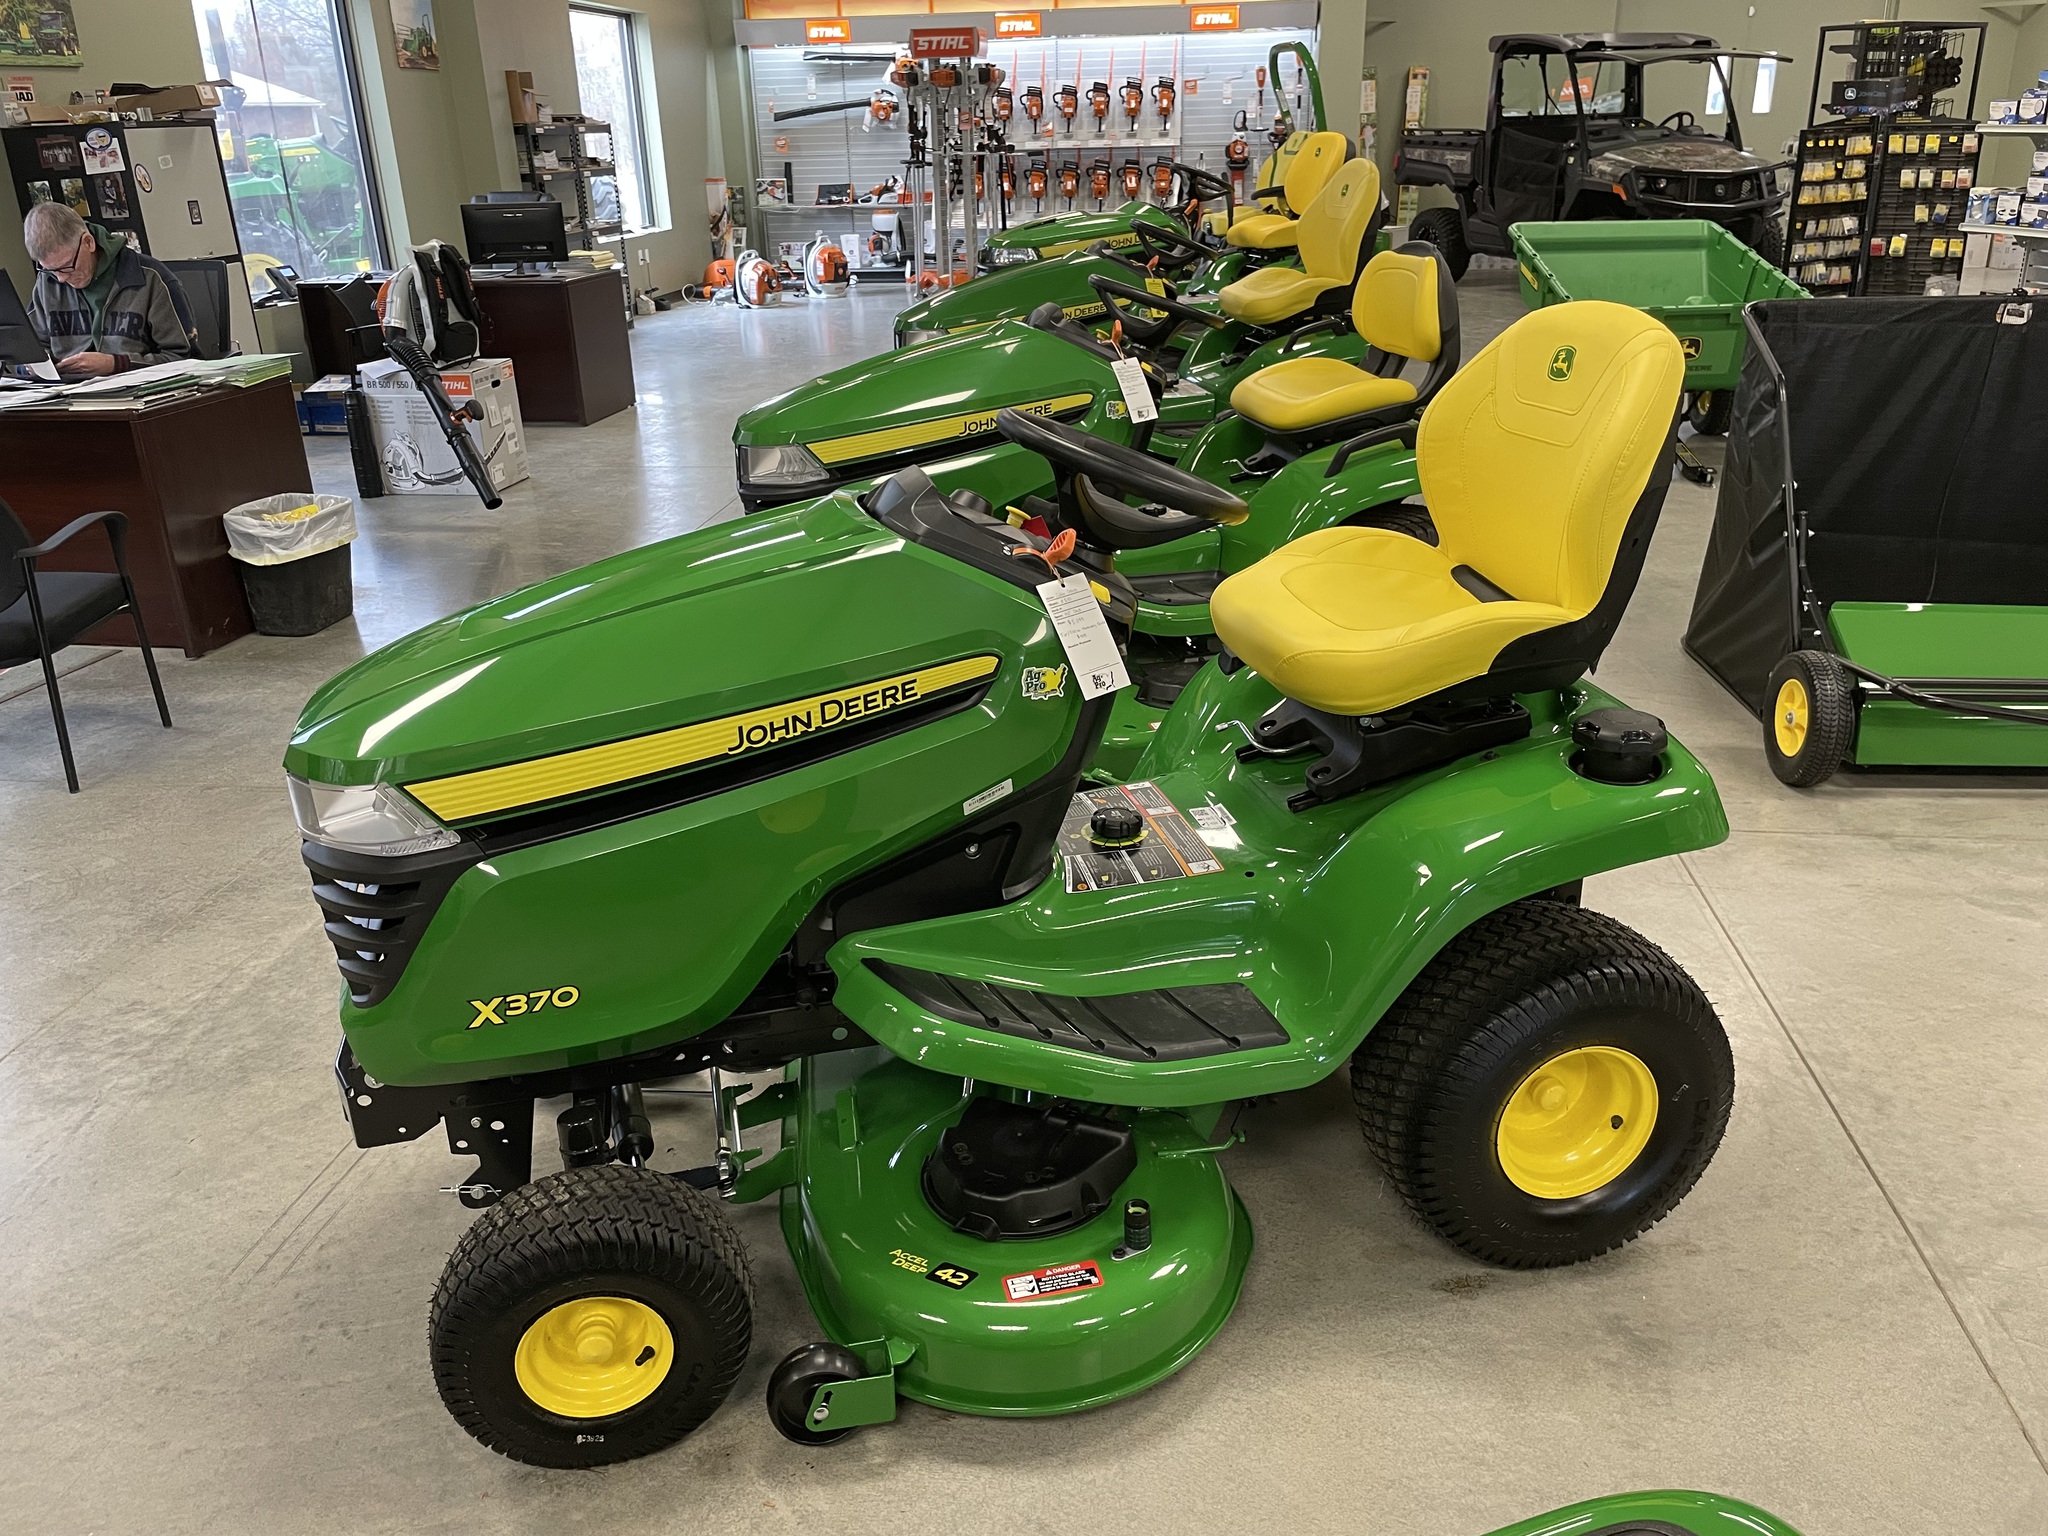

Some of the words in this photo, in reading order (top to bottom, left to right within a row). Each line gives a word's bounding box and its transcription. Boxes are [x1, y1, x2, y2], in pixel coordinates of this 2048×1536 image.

[999, 20, 1036, 32] STIHL
[1194, 13, 1234, 25] STIHL
[809, 27, 846, 38] STIHL
[916, 36, 970, 51] STIHL
[1074, 304, 1106, 318] DEERE
[366, 380, 378, 389] BR
[378, 380, 391, 389] 500
[396, 380, 409, 389] 550
[1025, 681, 1046, 693] Pro
[727, 711, 812, 753] JOHN
[819, 678, 918, 726] DEERE
[464, 985, 580, 1030] X370
[889, 1248, 929, 1267] ACCEL
[891, 1257, 928, 1273] DEEP
[1052, 1264, 1081, 1274] DANGER
[934, 1268, 970, 1286] 42
